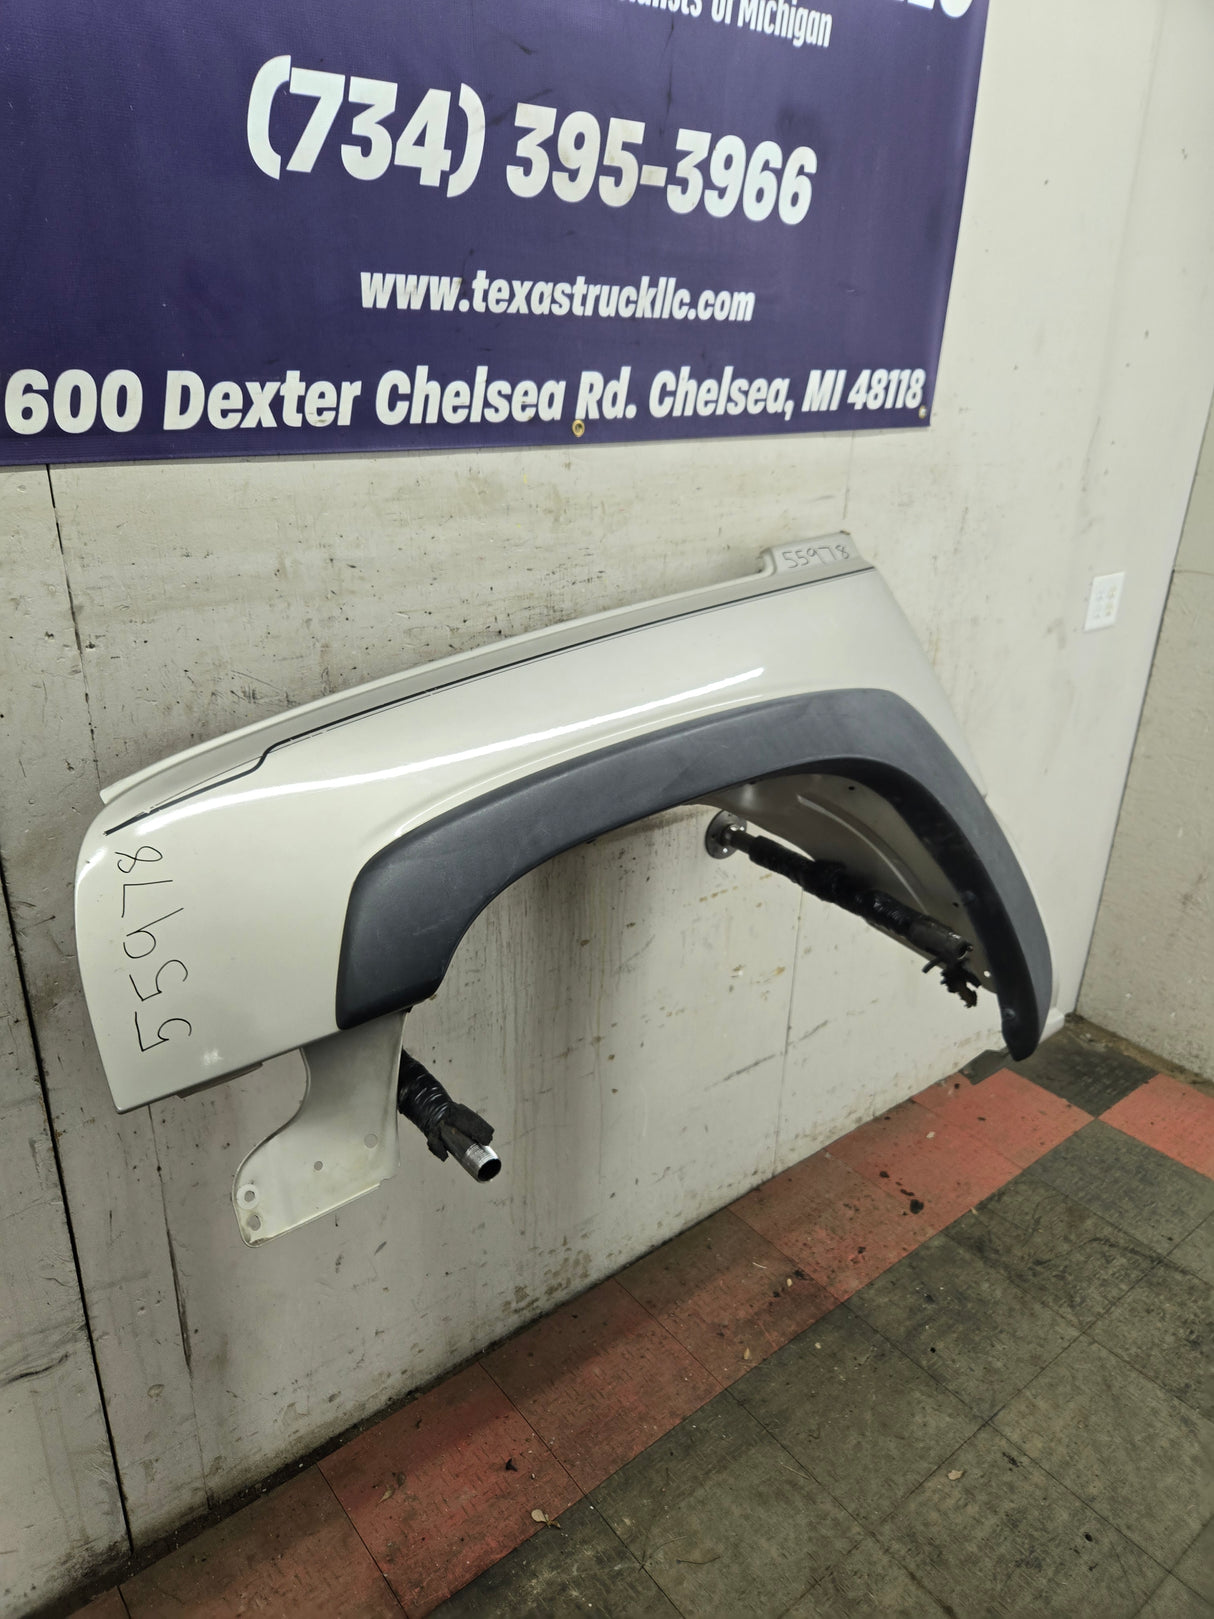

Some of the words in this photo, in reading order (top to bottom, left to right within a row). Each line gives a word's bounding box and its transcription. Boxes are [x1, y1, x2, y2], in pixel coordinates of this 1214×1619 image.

[736, 0, 833, 48] Michigan
[246, 55, 486, 198] (734)
[506, 102, 818, 226] 395-3966
[360, 269, 756, 323] www.texastruckllc.com
[4, 369, 143, 435] 600
[163, 370, 362, 431] Dexter
[375, 365, 567, 426] Chelsea
[574, 365, 637, 420] Rd.
[648, 365, 795, 421] Chelsea,
[801, 369, 847, 412] MI
[847, 368, 926, 411] 48118
[781, 544, 850, 569] 55978
[114, 845, 193, 1052] 55978
